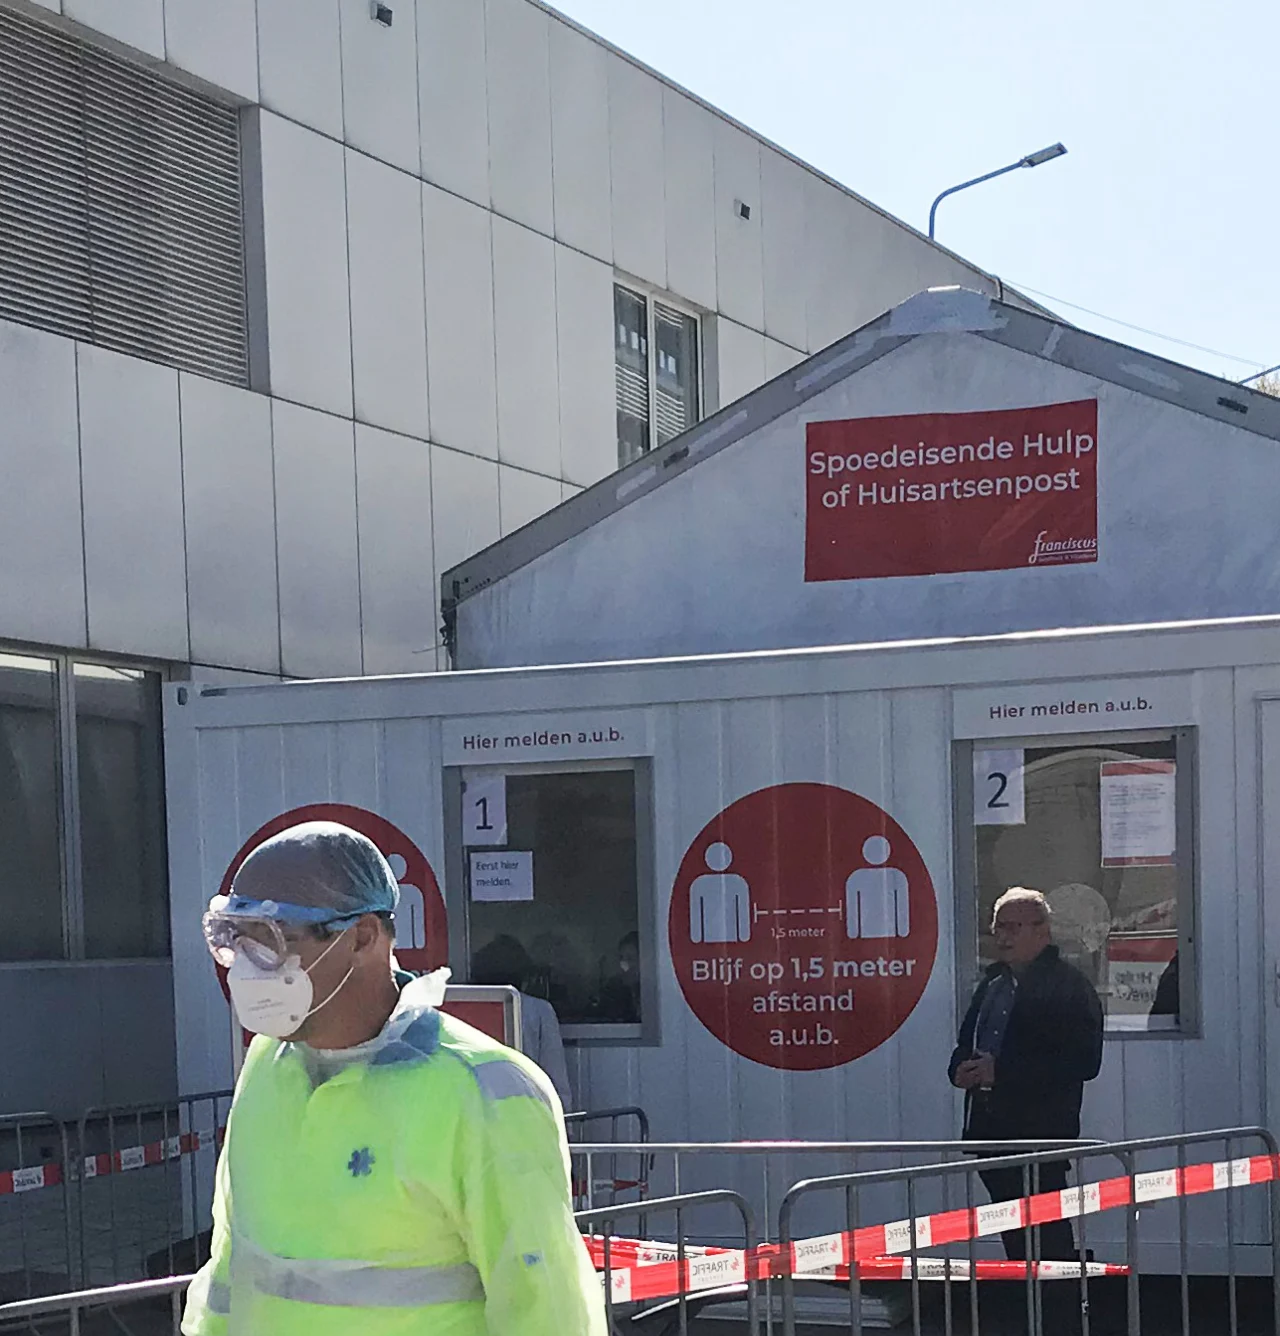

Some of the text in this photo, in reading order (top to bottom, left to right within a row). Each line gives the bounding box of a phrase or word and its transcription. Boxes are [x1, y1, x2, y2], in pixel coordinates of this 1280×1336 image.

[809, 429, 1095, 478] Spoedeisende Hulp
[821, 466, 1081, 509] of Huisartsenpost
[1028, 530, 1097, 564] franciscus
[989, 696, 1154, 720] Hier melden a.u.b.
[463, 727, 625, 750] Hier melden a.u.b.
[986, 771, 1011, 809] 2
[475, 797, 494, 831] 1
[475, 861, 499, 871] Eerst
[788, 925, 826, 939] meter
[692, 956, 917, 986] Blijf op 1,5 meter
[752, 988, 854, 1014] afstand
[768, 1022, 840, 1047] a.u.b.
